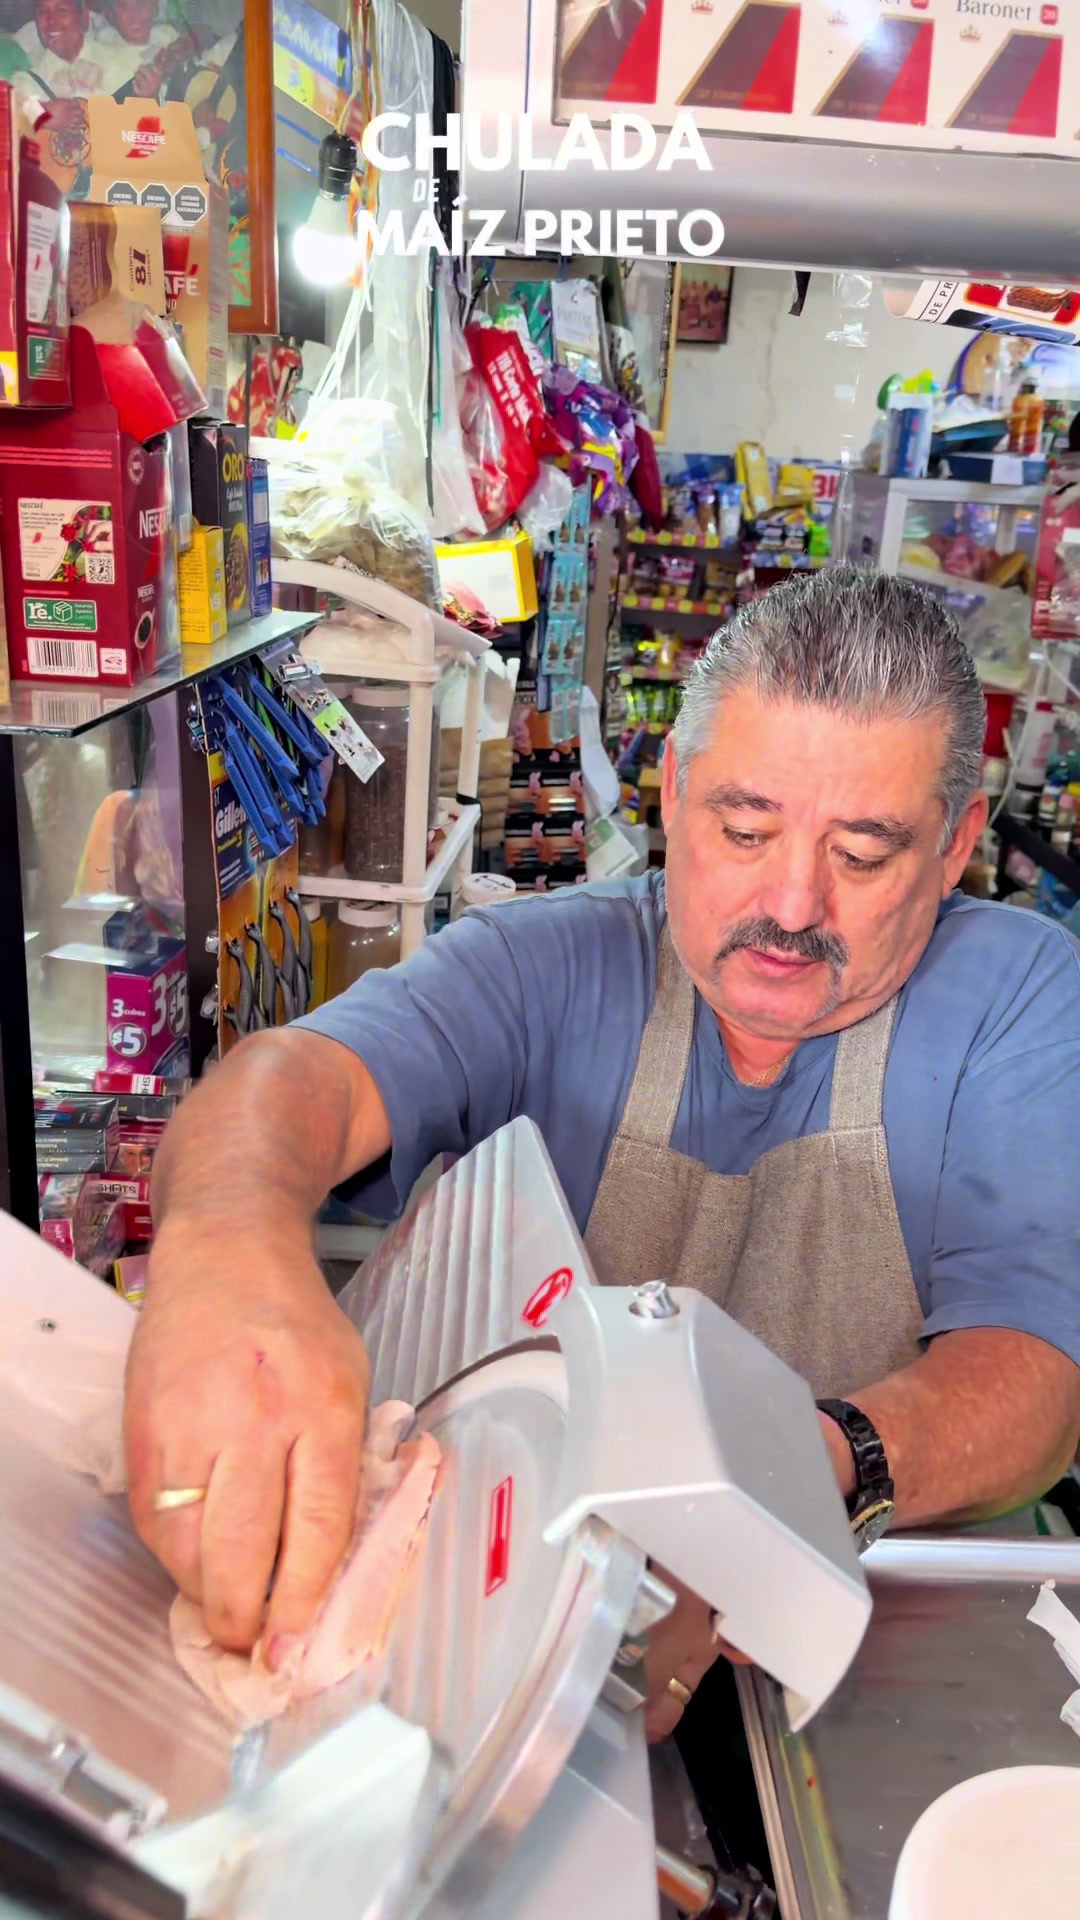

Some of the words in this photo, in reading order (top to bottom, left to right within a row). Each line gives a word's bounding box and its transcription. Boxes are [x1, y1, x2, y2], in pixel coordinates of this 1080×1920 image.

[956, 0, 1032, 21] Baronet
[928, 302, 943, 316] DE
[938, 281, 954, 297] PR
[222, 453, 245, 483] ORO
[111, 999, 124, 1018] 3
[151, 973, 167, 1036] 3
[112, 1026, 142, 1055] $5
